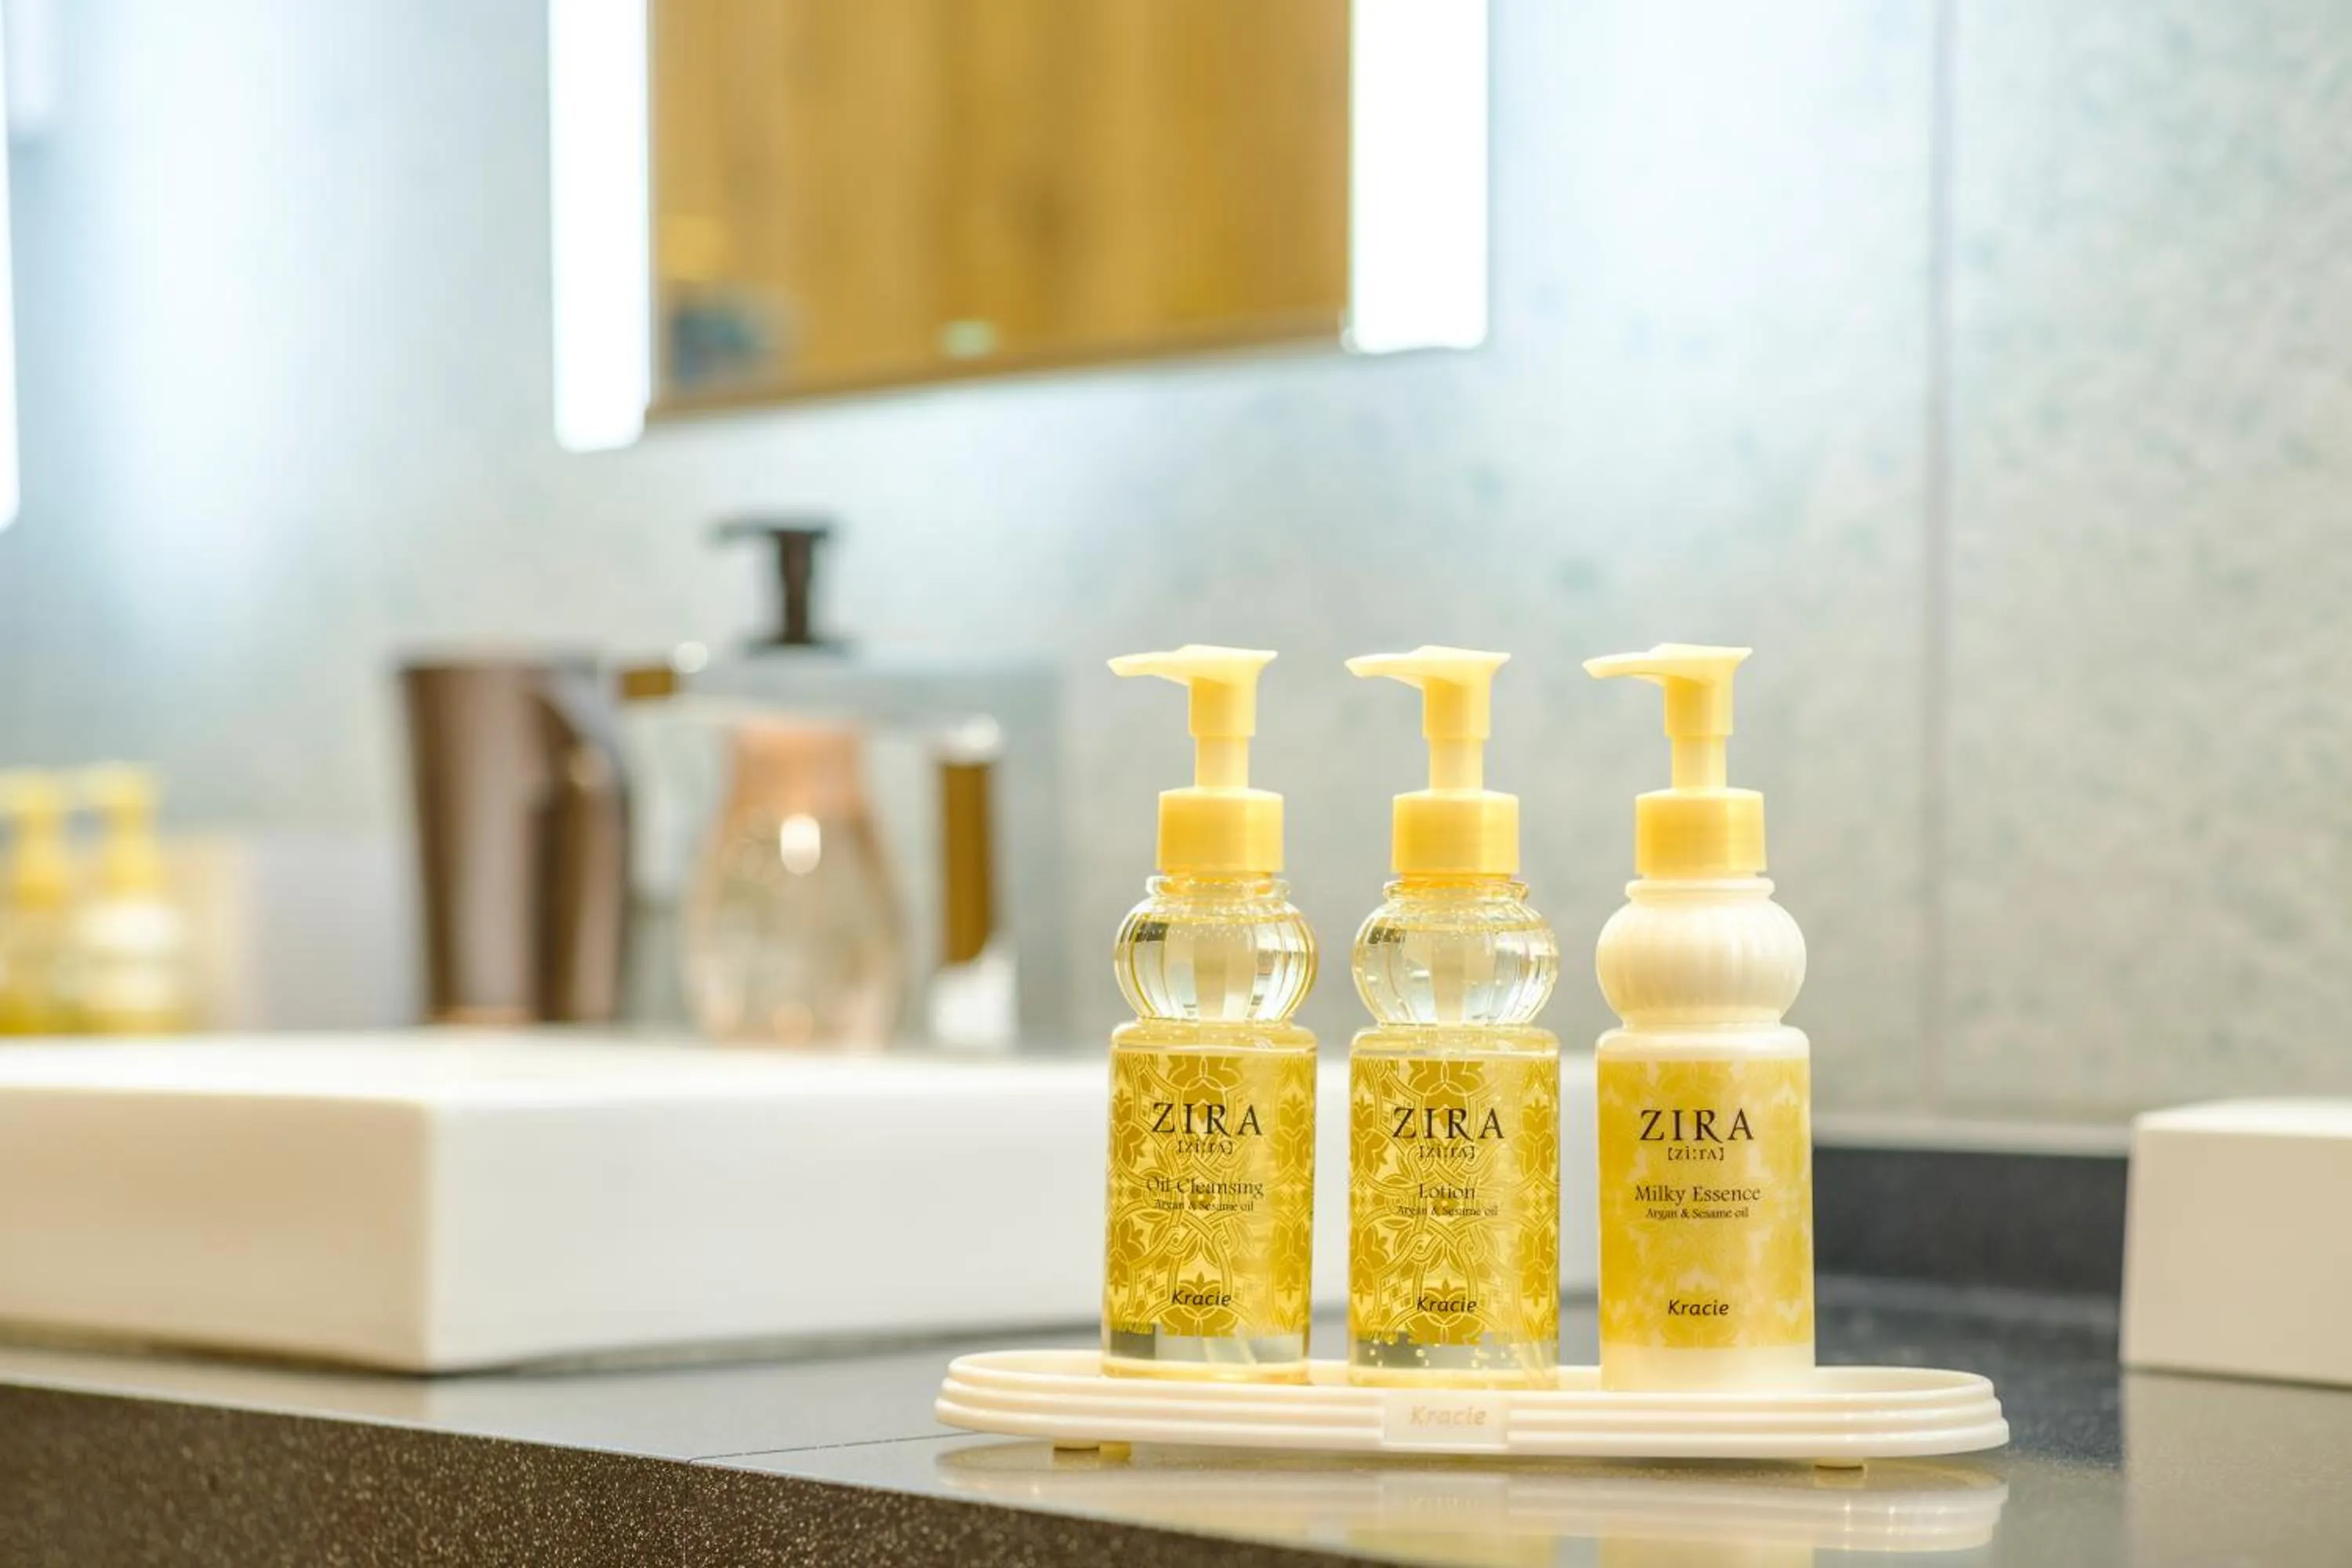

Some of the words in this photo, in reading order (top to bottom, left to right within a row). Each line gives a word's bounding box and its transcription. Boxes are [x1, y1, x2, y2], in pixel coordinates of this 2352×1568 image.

[1152, 1102, 1261, 1135] ZIRA
[1392, 1106, 1504, 1141] ZIRA
[1640, 1109, 1755, 1143] ZIRA
[1147, 1176, 1171, 1192] Oil
[1177, 1178, 1264, 1198] Cleansing
[1419, 1182, 1475, 1199] Lotion
[1635, 1185, 1686, 1206] Milky
[1693, 1186, 1761, 1202] Essence
[1646, 1207, 1678, 1221] Argan
[1680, 1208, 1689, 1219] &
[1692, 1208, 1733, 1219] Sesame
[1734, 1207, 1750, 1218] oil
[1171, 1290, 1232, 1308] Kracie
[1417, 1297, 1478, 1314] Kracie
[1668, 1299, 1730, 1316] Kracie
[1410, 1405, 1487, 1426] Kracie
